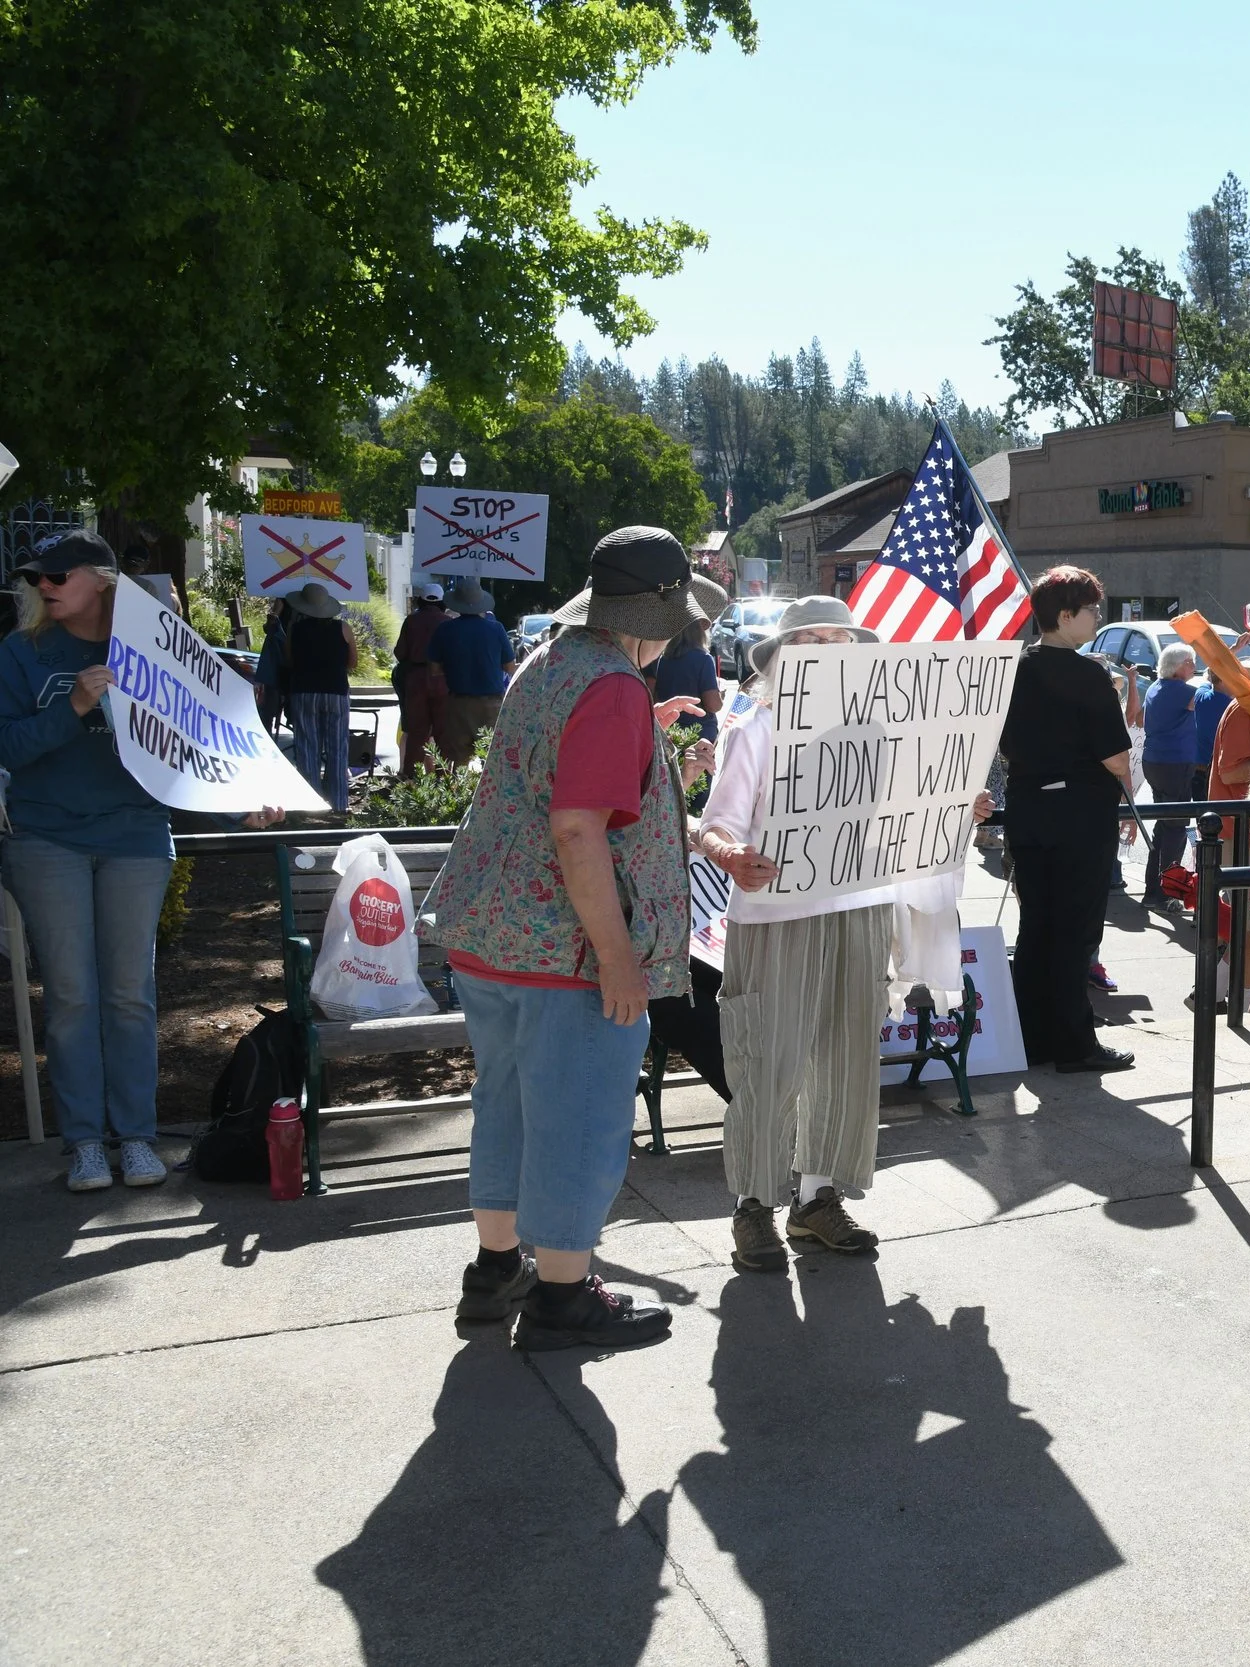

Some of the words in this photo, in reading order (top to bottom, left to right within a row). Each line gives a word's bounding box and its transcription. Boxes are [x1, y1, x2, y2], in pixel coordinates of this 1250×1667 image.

[265, 497, 315, 512] BEDFORD
[319, 500, 340, 514] AVE
[450, 496, 515, 521] STOP
[1098, 488, 1133, 513] Round
[1151, 481, 1181, 509] Table
[1134, 504, 1149, 512] PIZZA
[155, 610, 222, 696] SUPPORT
[776, 659, 820, 731] HE
[840, 652, 949, 727] WASN'T
[949, 654, 1013, 718] SHOT
[770, 743, 807, 816] HE
[815, 736, 903, 811] DIDN'T
[917, 733, 975, 797] WIN
[830, 818, 871, 886] ON
[873, 812, 915, 878] THE
[374, 971, 398, 985] Bliss
